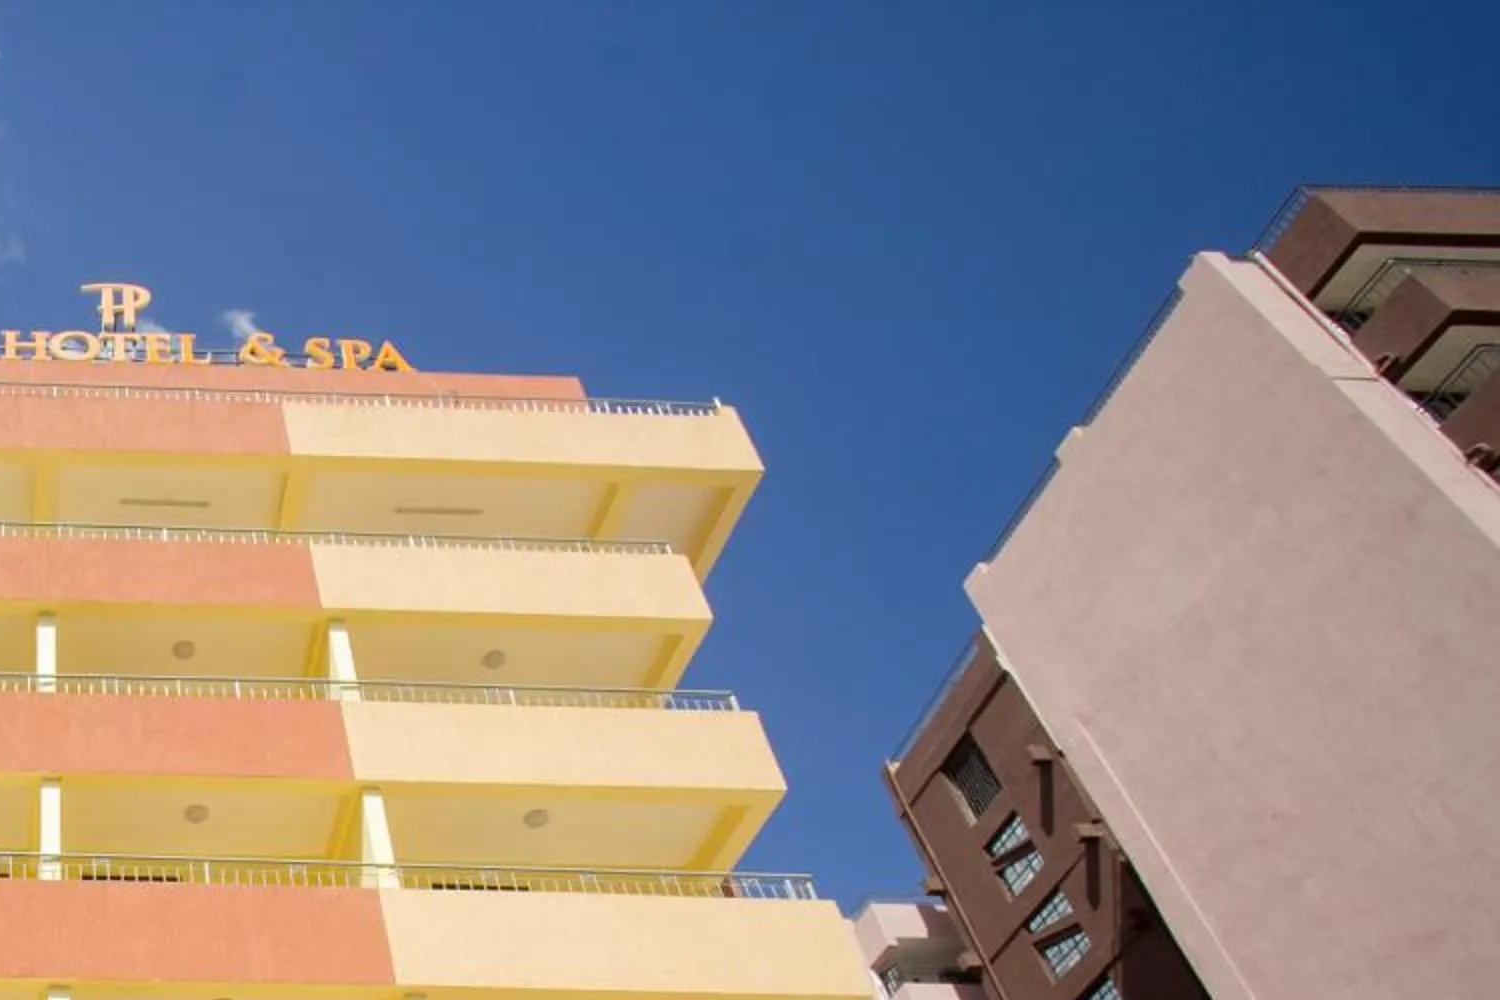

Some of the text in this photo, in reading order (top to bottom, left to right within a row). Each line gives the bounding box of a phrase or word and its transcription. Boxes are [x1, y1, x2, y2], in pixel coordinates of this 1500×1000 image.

[0, 329, 212, 364] HOTEL
[239, 331, 291, 367] &
[304, 336, 419, 373] SPA
